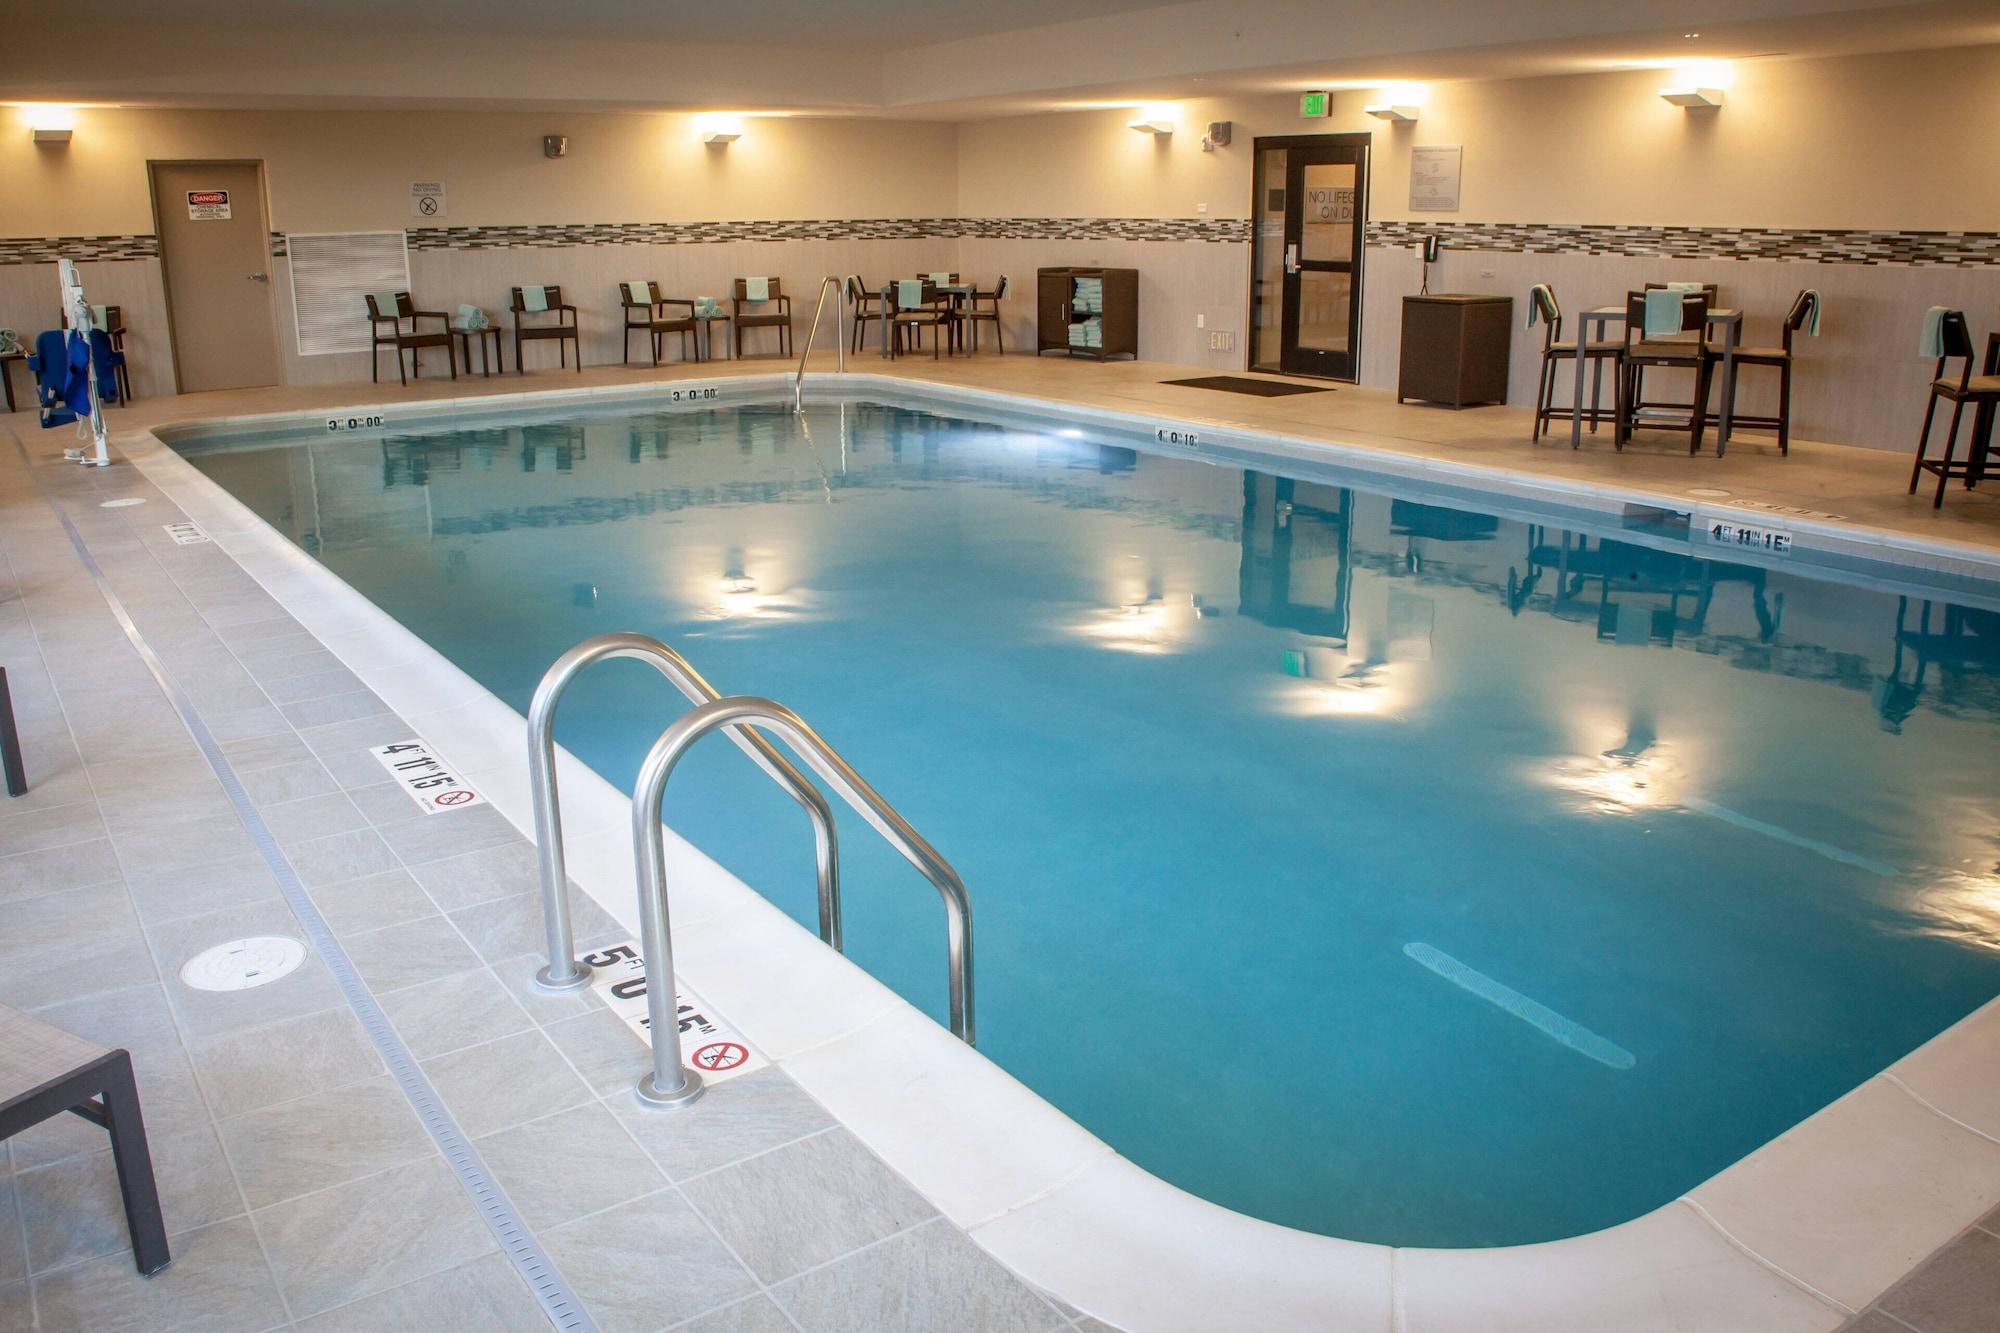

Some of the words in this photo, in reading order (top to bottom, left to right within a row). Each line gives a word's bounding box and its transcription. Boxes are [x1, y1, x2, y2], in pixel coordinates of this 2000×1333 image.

[1305, 95, 1324, 115] EXIT
[1309, 191, 1325, 203] NO
[1321, 206, 1337, 219] ON
[1211, 332, 1230, 350] EXIT
[1737, 528, 1751, 545] 11
[382, 744, 420, 755] 4
[394, 757, 436, 771] 11
[583, 945, 638, 968] 5
